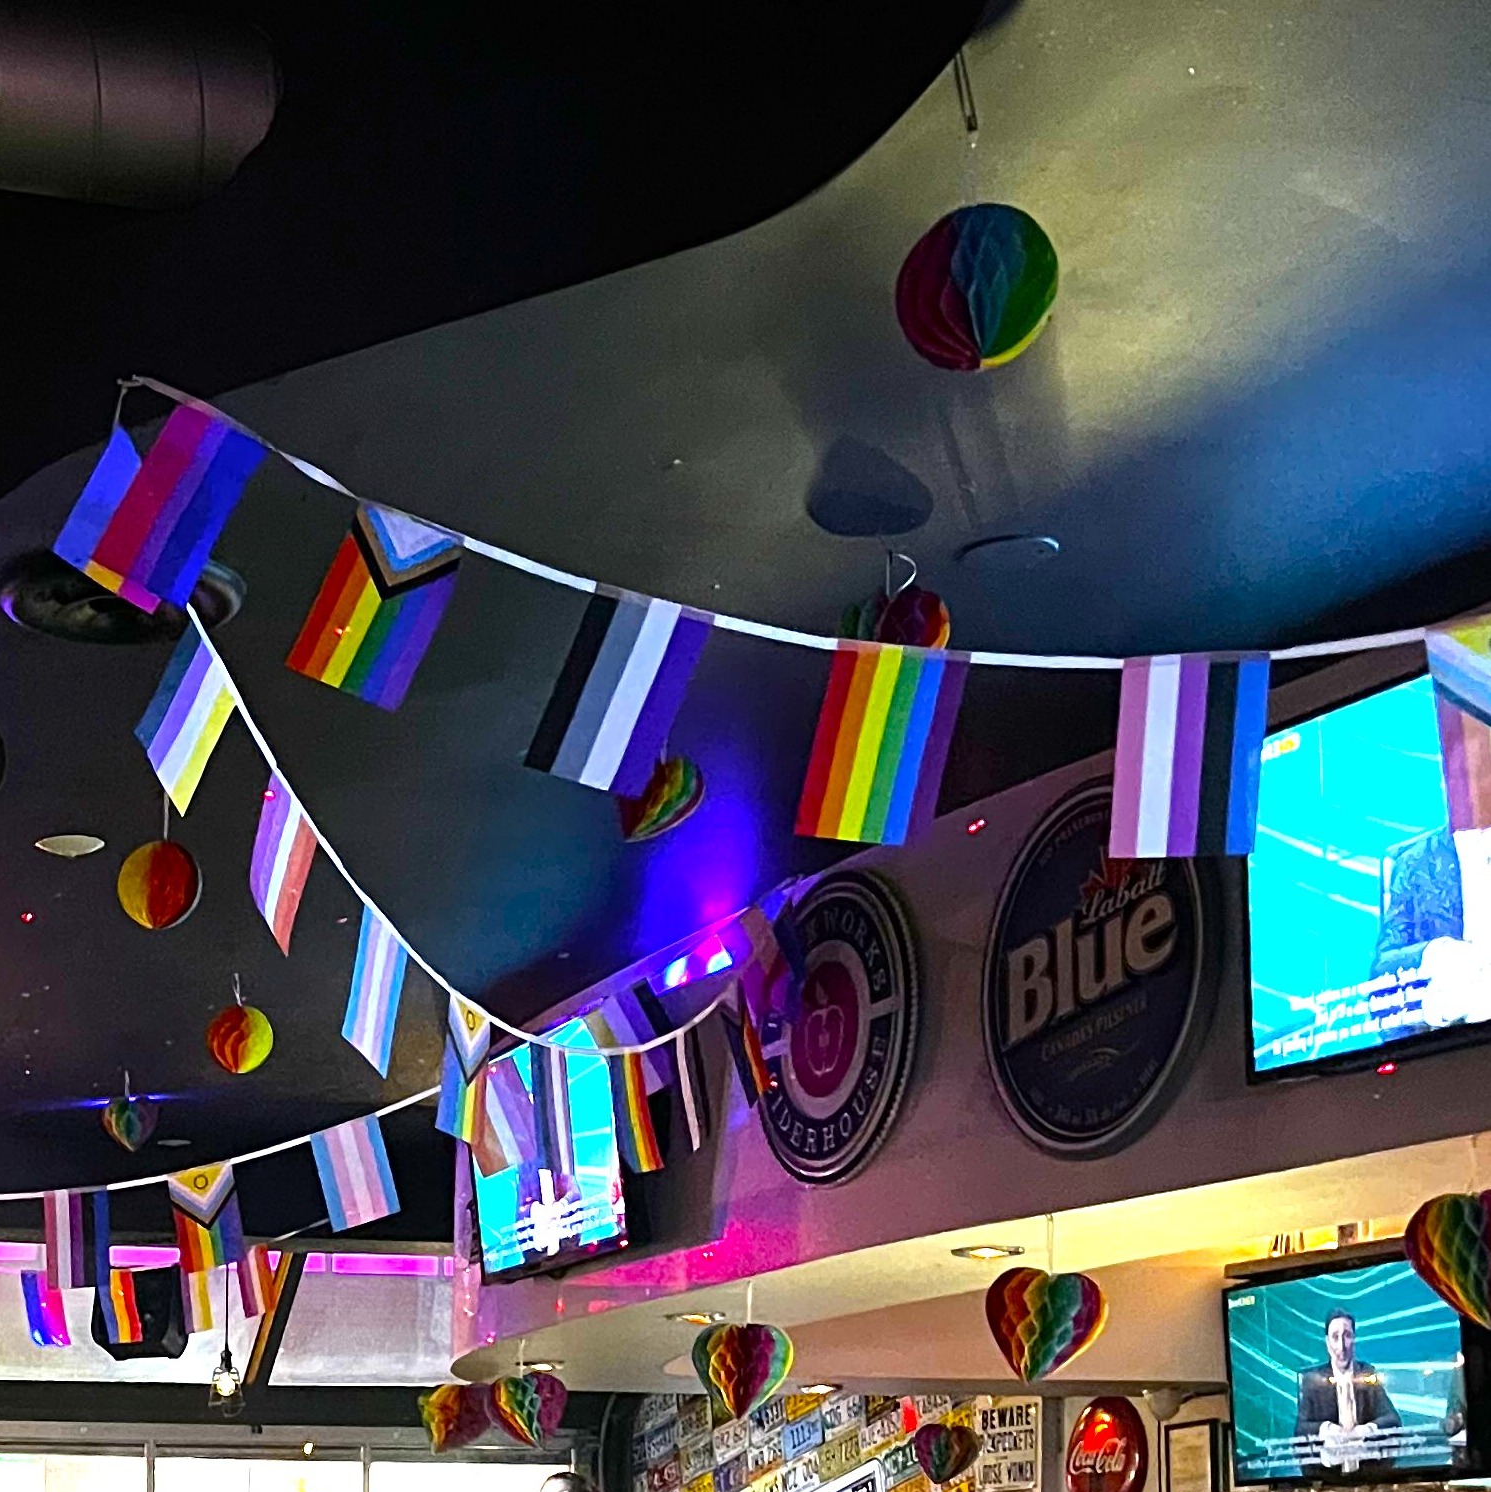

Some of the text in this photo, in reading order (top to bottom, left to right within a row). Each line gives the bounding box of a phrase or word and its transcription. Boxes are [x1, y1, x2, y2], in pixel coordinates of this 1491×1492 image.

[1080, 860, 1168, 927] Labatt
[1005, 891, 1177, 1045] Blue
[981, 1403, 1032, 1431] BEWARE
